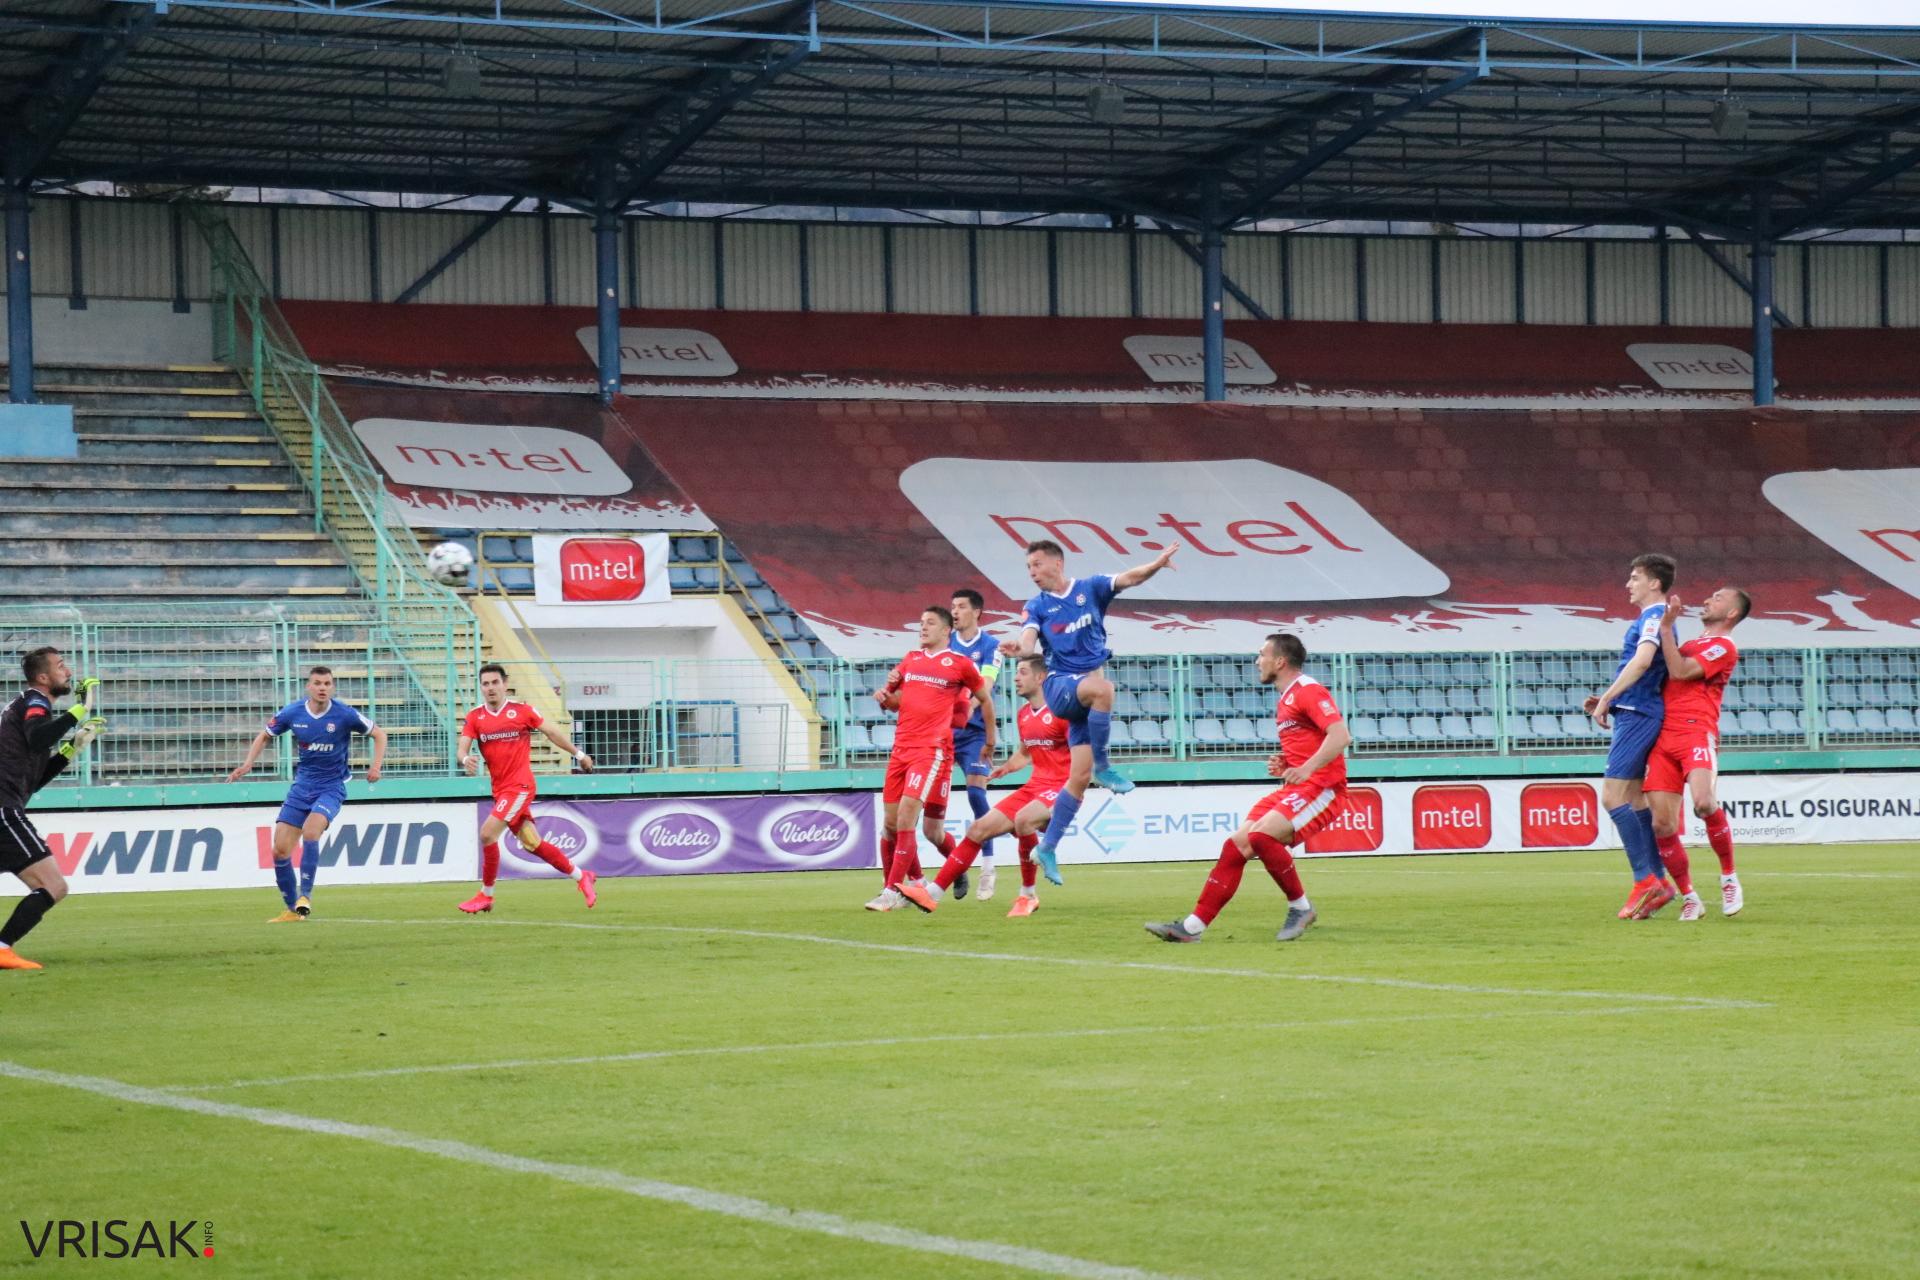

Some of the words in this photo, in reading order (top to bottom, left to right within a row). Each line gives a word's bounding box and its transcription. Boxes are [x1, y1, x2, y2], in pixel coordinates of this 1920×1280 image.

[1149, 351, 1253, 370] m:el
[1653, 358, 1753, 375] m:tel
[396, 445, 592, 473] m:tel
[988, 501, 1364, 557] m:tel
[569, 555, 636, 580] m:tel
[1693, 747, 1710, 762] 21
[908, 772, 922, 790] 14
[941, 781, 949, 798] 6
[496, 799, 508, 813] 8
[1281, 792, 1307, 813] 24
[1694, 800, 1794, 819] NTRAL
[1322, 805, 1375, 831] :tel
[1421, 802, 1482, 829] m:tel
[1529, 800, 1590, 827] m:tel
[649, 825, 711, 848] Violeta
[779, 821, 841, 844] Violeta
[1733, 825, 1796, 838] povjerenjem
